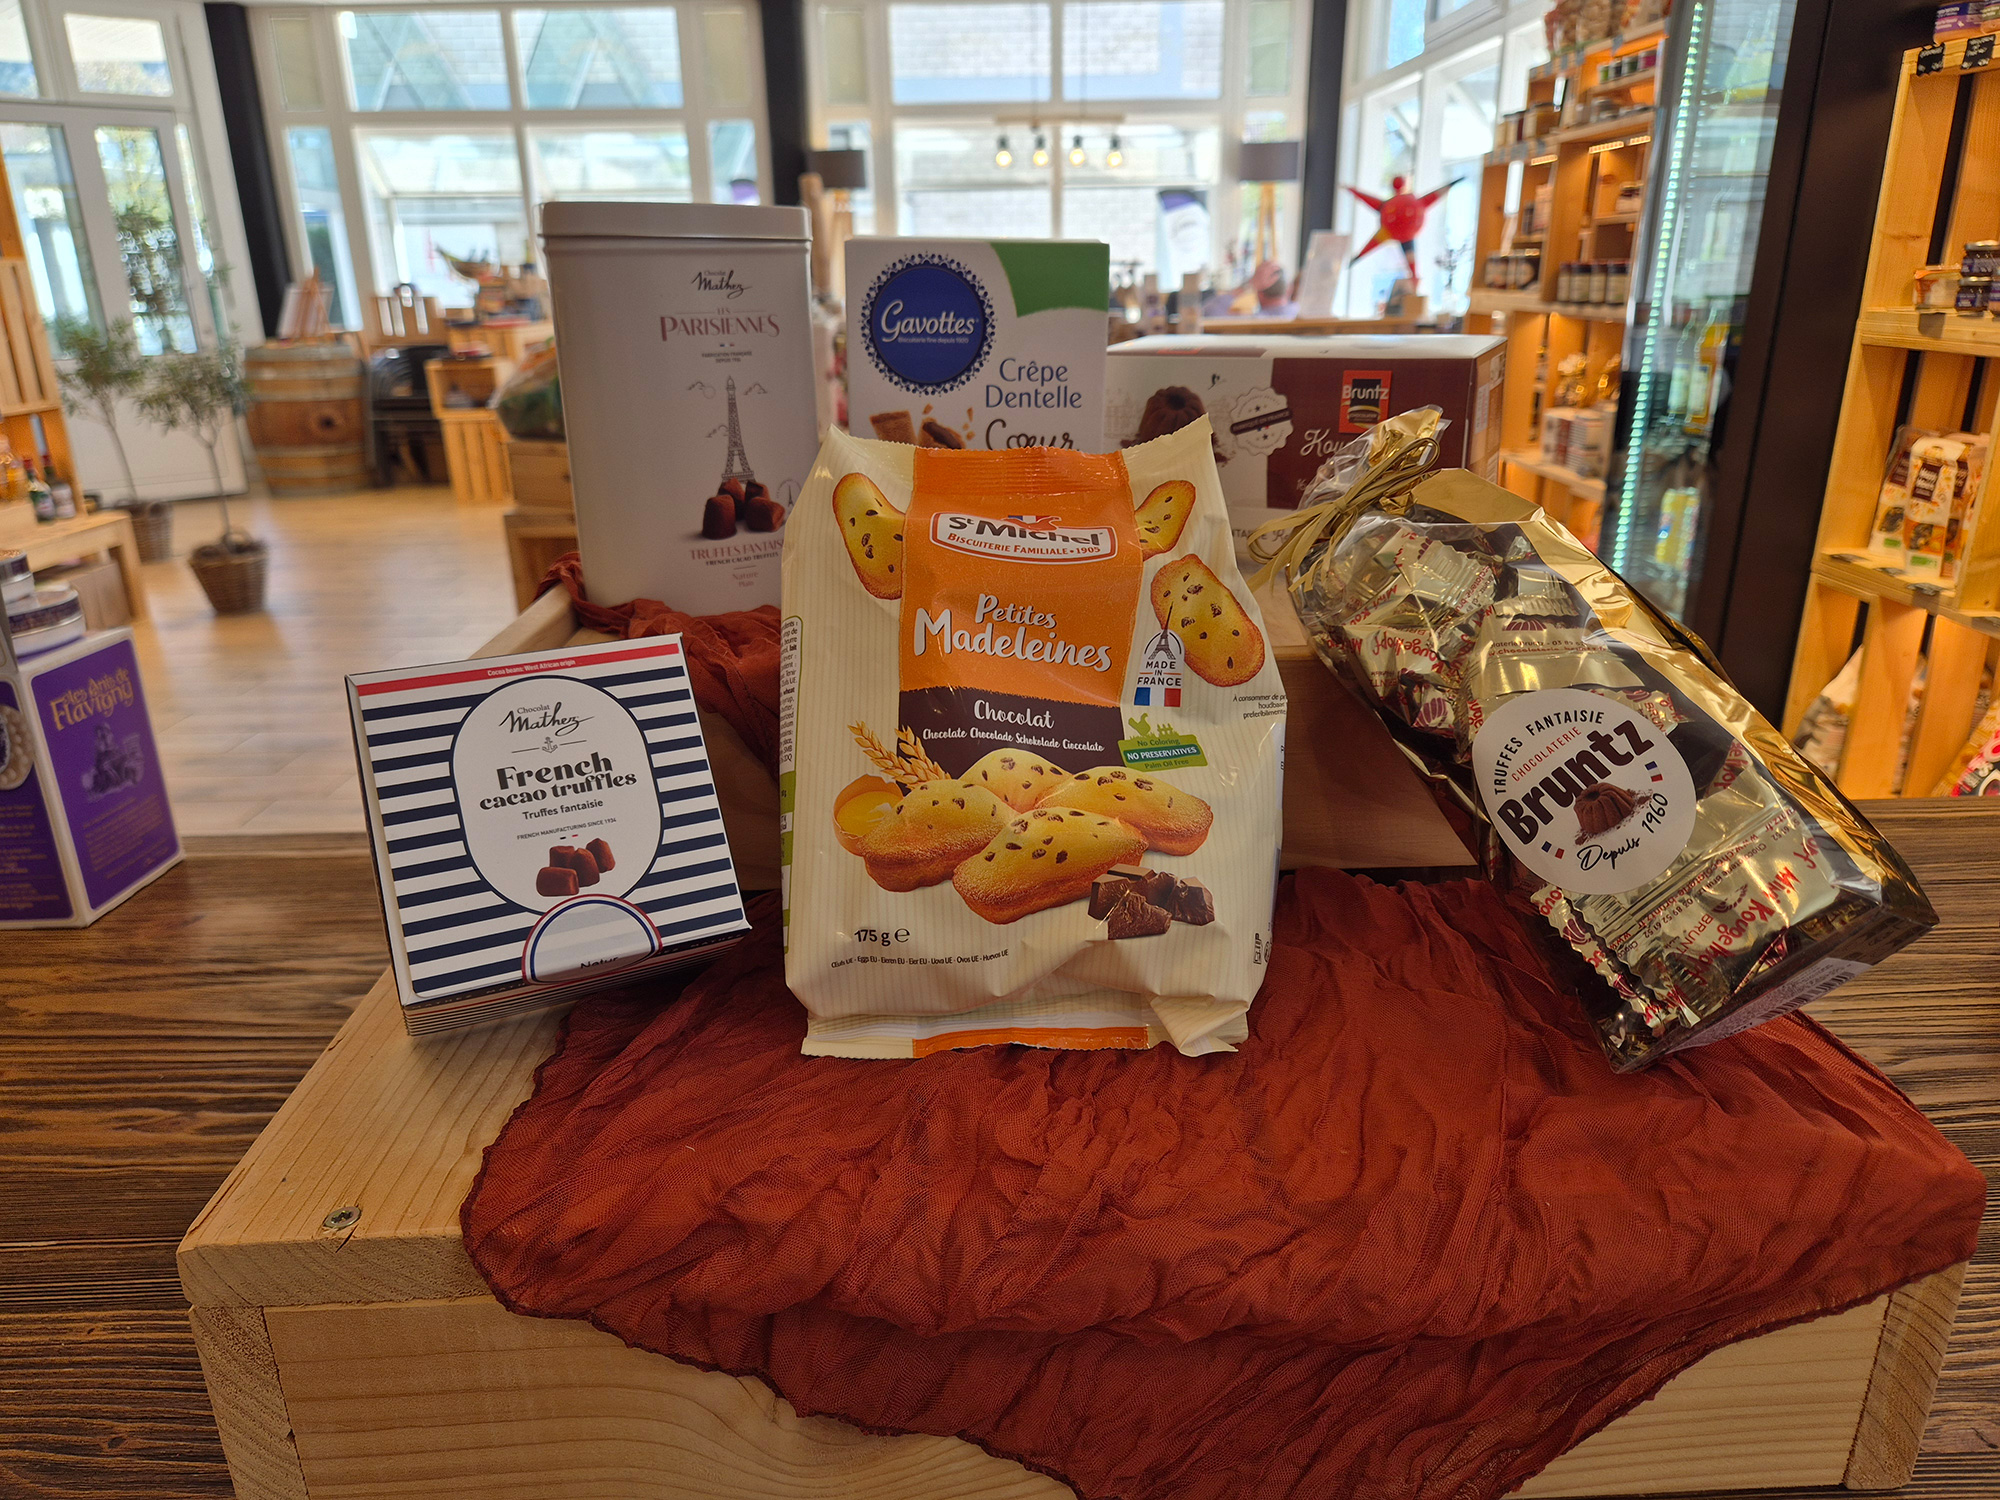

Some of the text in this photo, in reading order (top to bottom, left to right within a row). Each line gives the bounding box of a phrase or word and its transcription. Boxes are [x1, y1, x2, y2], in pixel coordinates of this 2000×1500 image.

[691, 269, 753, 300] Mathez
[660, 314, 780, 341] PARISIENNES
[881, 299, 976, 342] Gavottes
[999, 358, 1068, 387] Crêpe
[986, 384, 1082, 409] Dentelle
[1342, 384, 1389, 400] Bruntz
[947, 532, 1101, 556] BISCUITERIE FAMILIALE 1905
[976, 519, 1102, 547] Michel
[975, 593, 1057, 629] Petites
[914, 607, 1113, 672] Madeleines
[540, 661, 559, 669] African
[1145, 660, 1175, 670] MADE
[1137, 677, 1181, 687] FRANCE
[50, 682, 134, 731] Flavigny
[499, 701, 595, 738] Mathez
[517, 704, 550, 715] Chocolat
[973, 699, 1055, 729] Chocolat
[922, 727, 967, 740] Chocolate
[970, 727, 1014, 742] Chocolade
[1015, 732, 1061, 748] Schokolade
[1150, 738, 1181, 746] Coloring
[1126, 746, 1197, 761] NO PRESERVATIVES
[1145, 759, 1189, 770] Palm Oil Free
[1494, 709, 1605, 796] TRUFFES FANTAISIE
[1511, 726, 1582, 782] CHOCOLATERIE
[496, 751, 613, 791] French
[1497, 720, 1655, 845] Bruntz
[479, 770, 638, 811] cacao truffles
[522, 798, 604, 821] Truffes fantaisie
[517, 832, 540, 840] FRENCH
[541, 822, 587, 836] MANUFACTURING
[587, 820, 604, 828] SINCE
[1577, 792, 1669, 871] Depuis 1960
[854, 928, 876, 943] 175
[881, 933, 890, 947] g
